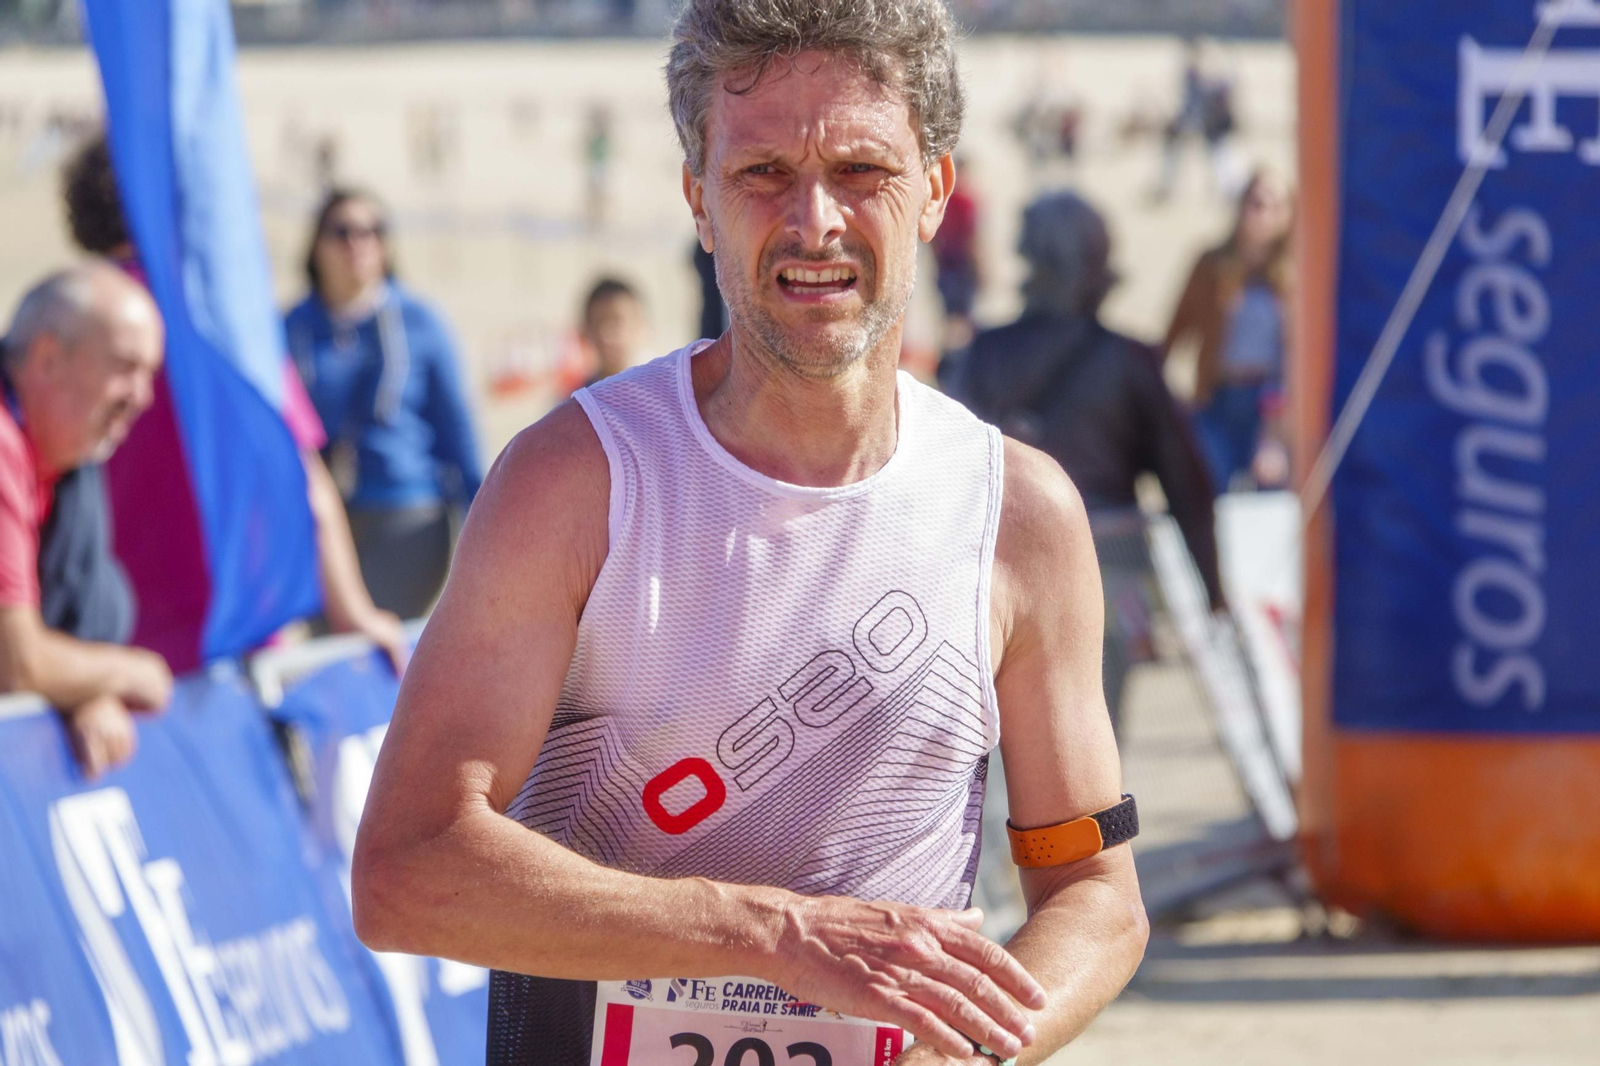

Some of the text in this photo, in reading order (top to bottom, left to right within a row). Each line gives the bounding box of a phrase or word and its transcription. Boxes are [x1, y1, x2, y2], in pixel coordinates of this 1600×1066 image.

[1423, 203, 1552, 712] seguros
[684, 1000, 719, 1011] seguros
[721, 998, 817, 1018] PRAIA DE SAMIL
